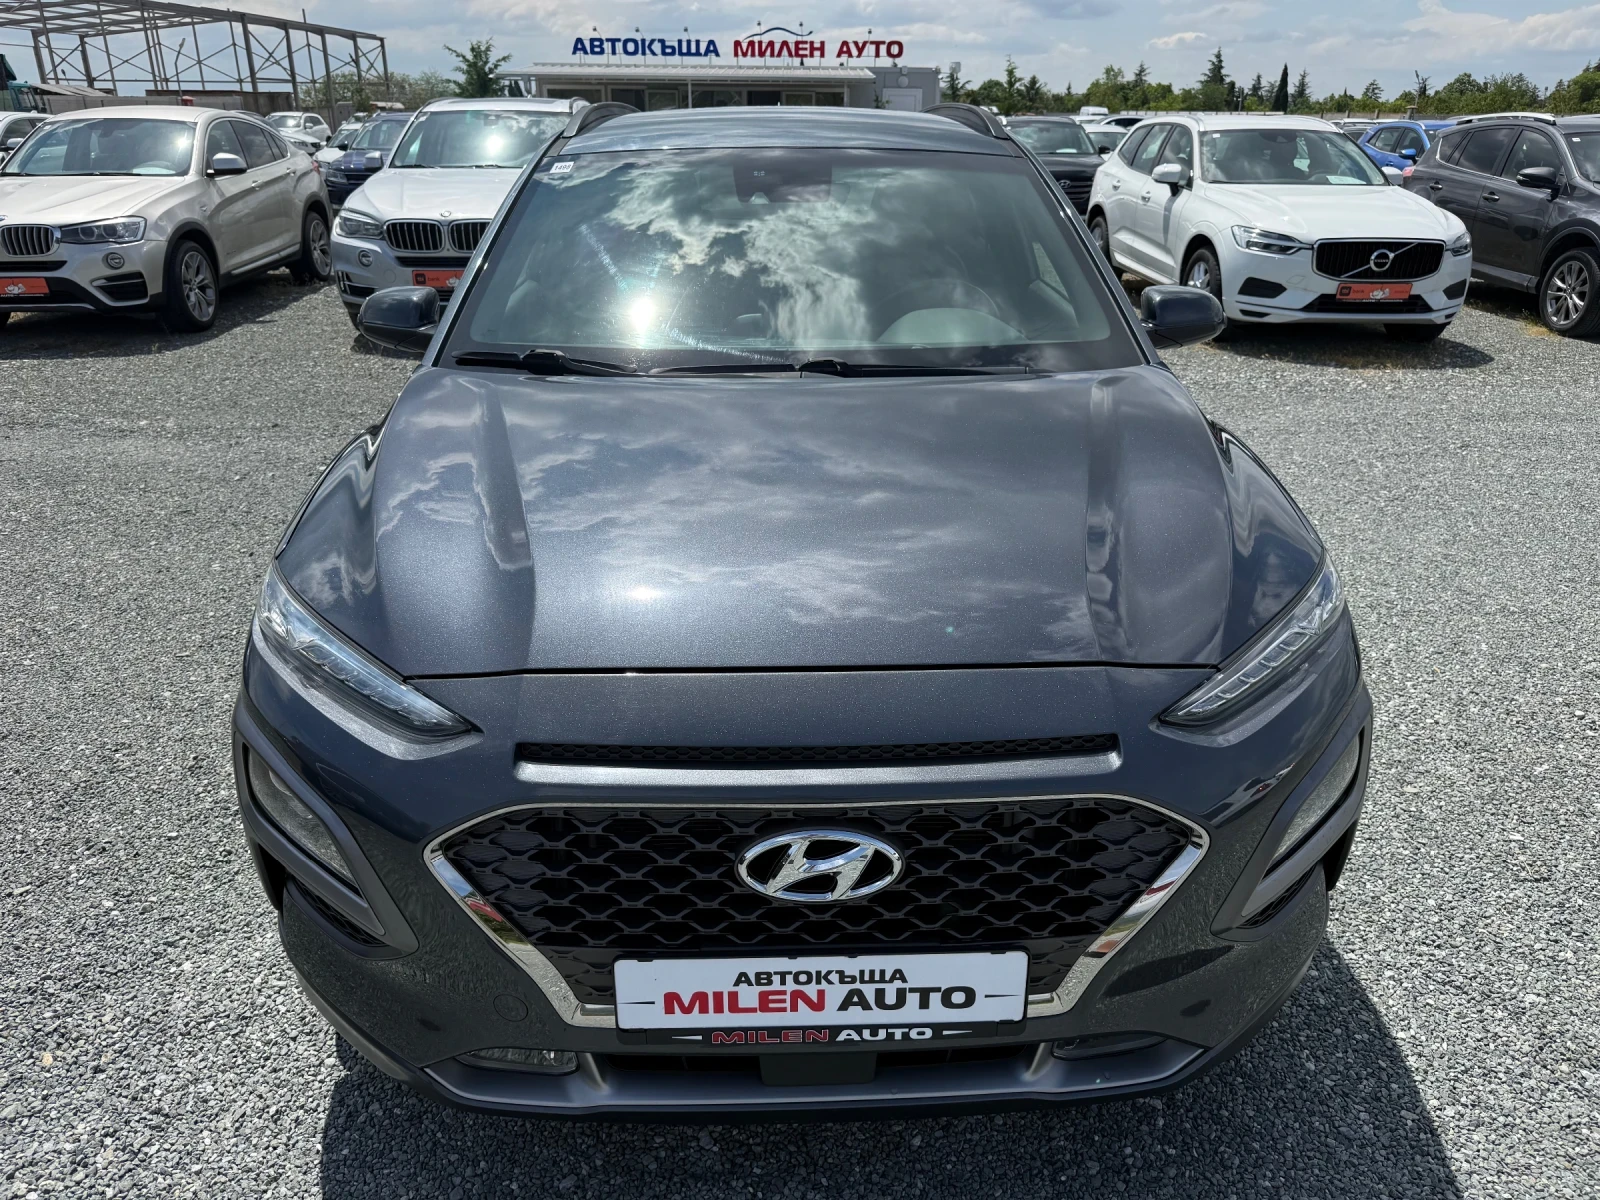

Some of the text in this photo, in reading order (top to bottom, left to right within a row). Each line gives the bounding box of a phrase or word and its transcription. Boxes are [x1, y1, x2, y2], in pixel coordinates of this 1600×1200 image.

[733, 39, 825, 58] МИЛЕН
[836, 39, 904, 58] АУТО
[663, 985, 976, 1015] MILEN AUTO
[711, 1027, 933, 1044] MILEN AUTO
